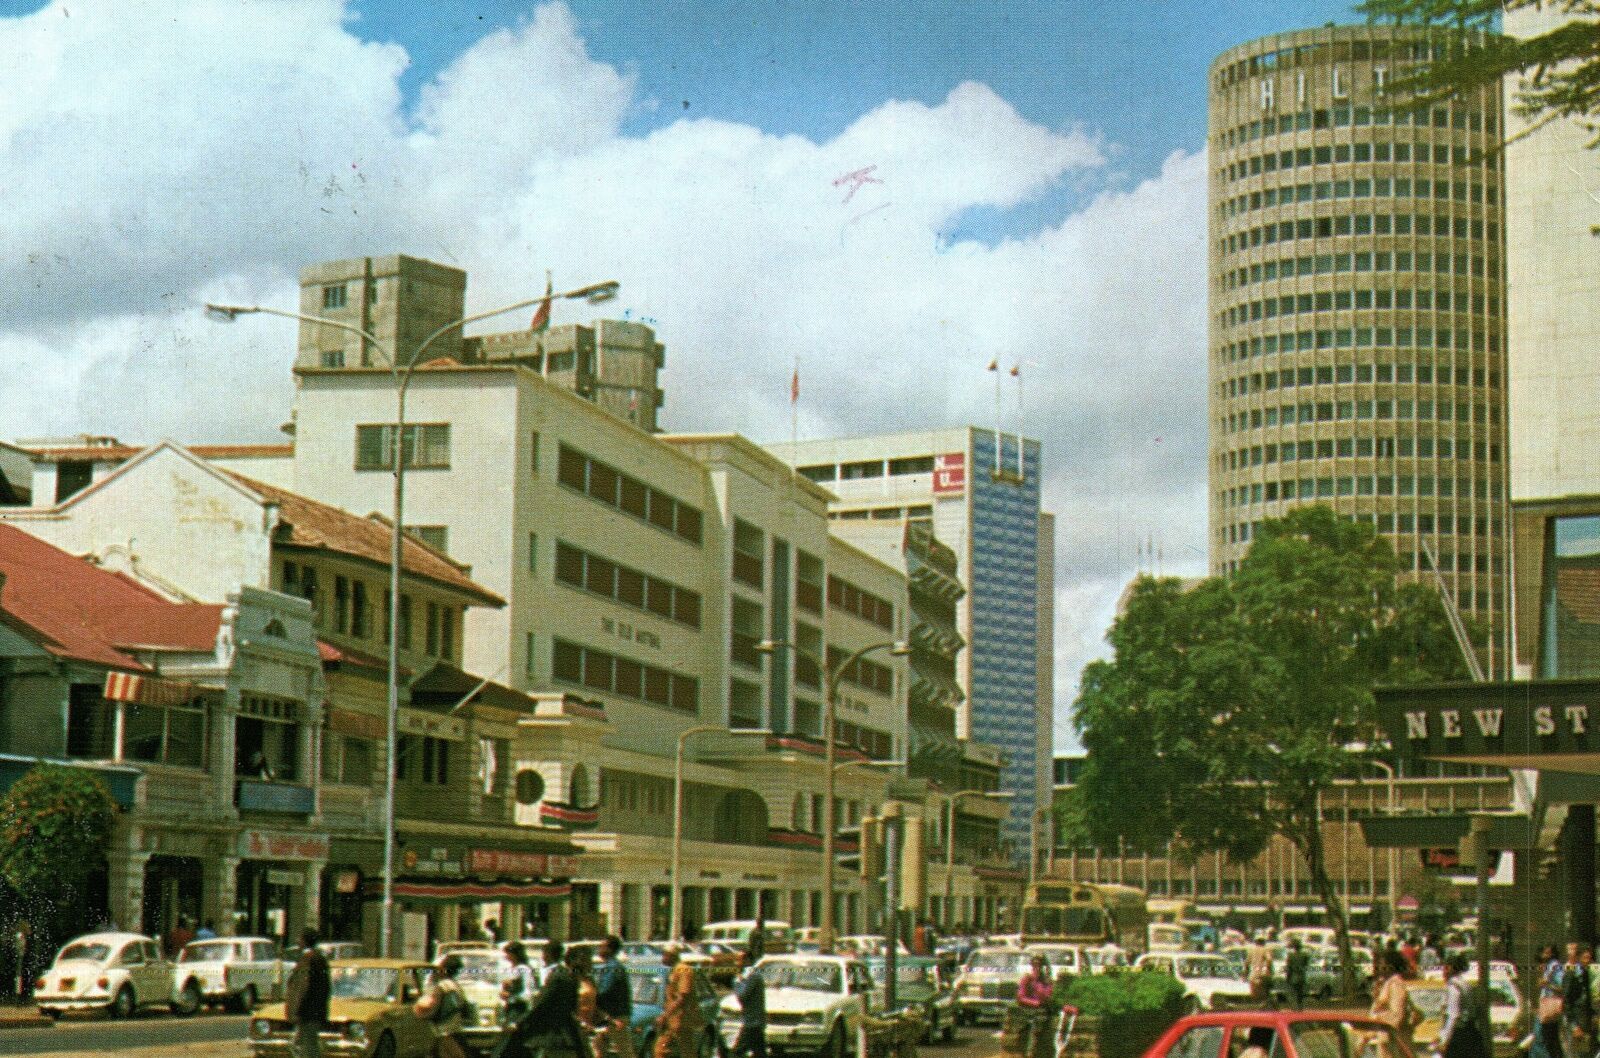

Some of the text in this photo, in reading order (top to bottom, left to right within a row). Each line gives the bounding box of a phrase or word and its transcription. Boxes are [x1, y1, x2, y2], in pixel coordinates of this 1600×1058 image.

[1261, 65, 1467, 111] HILT
[1404, 705, 1588, 739] NEW ST
